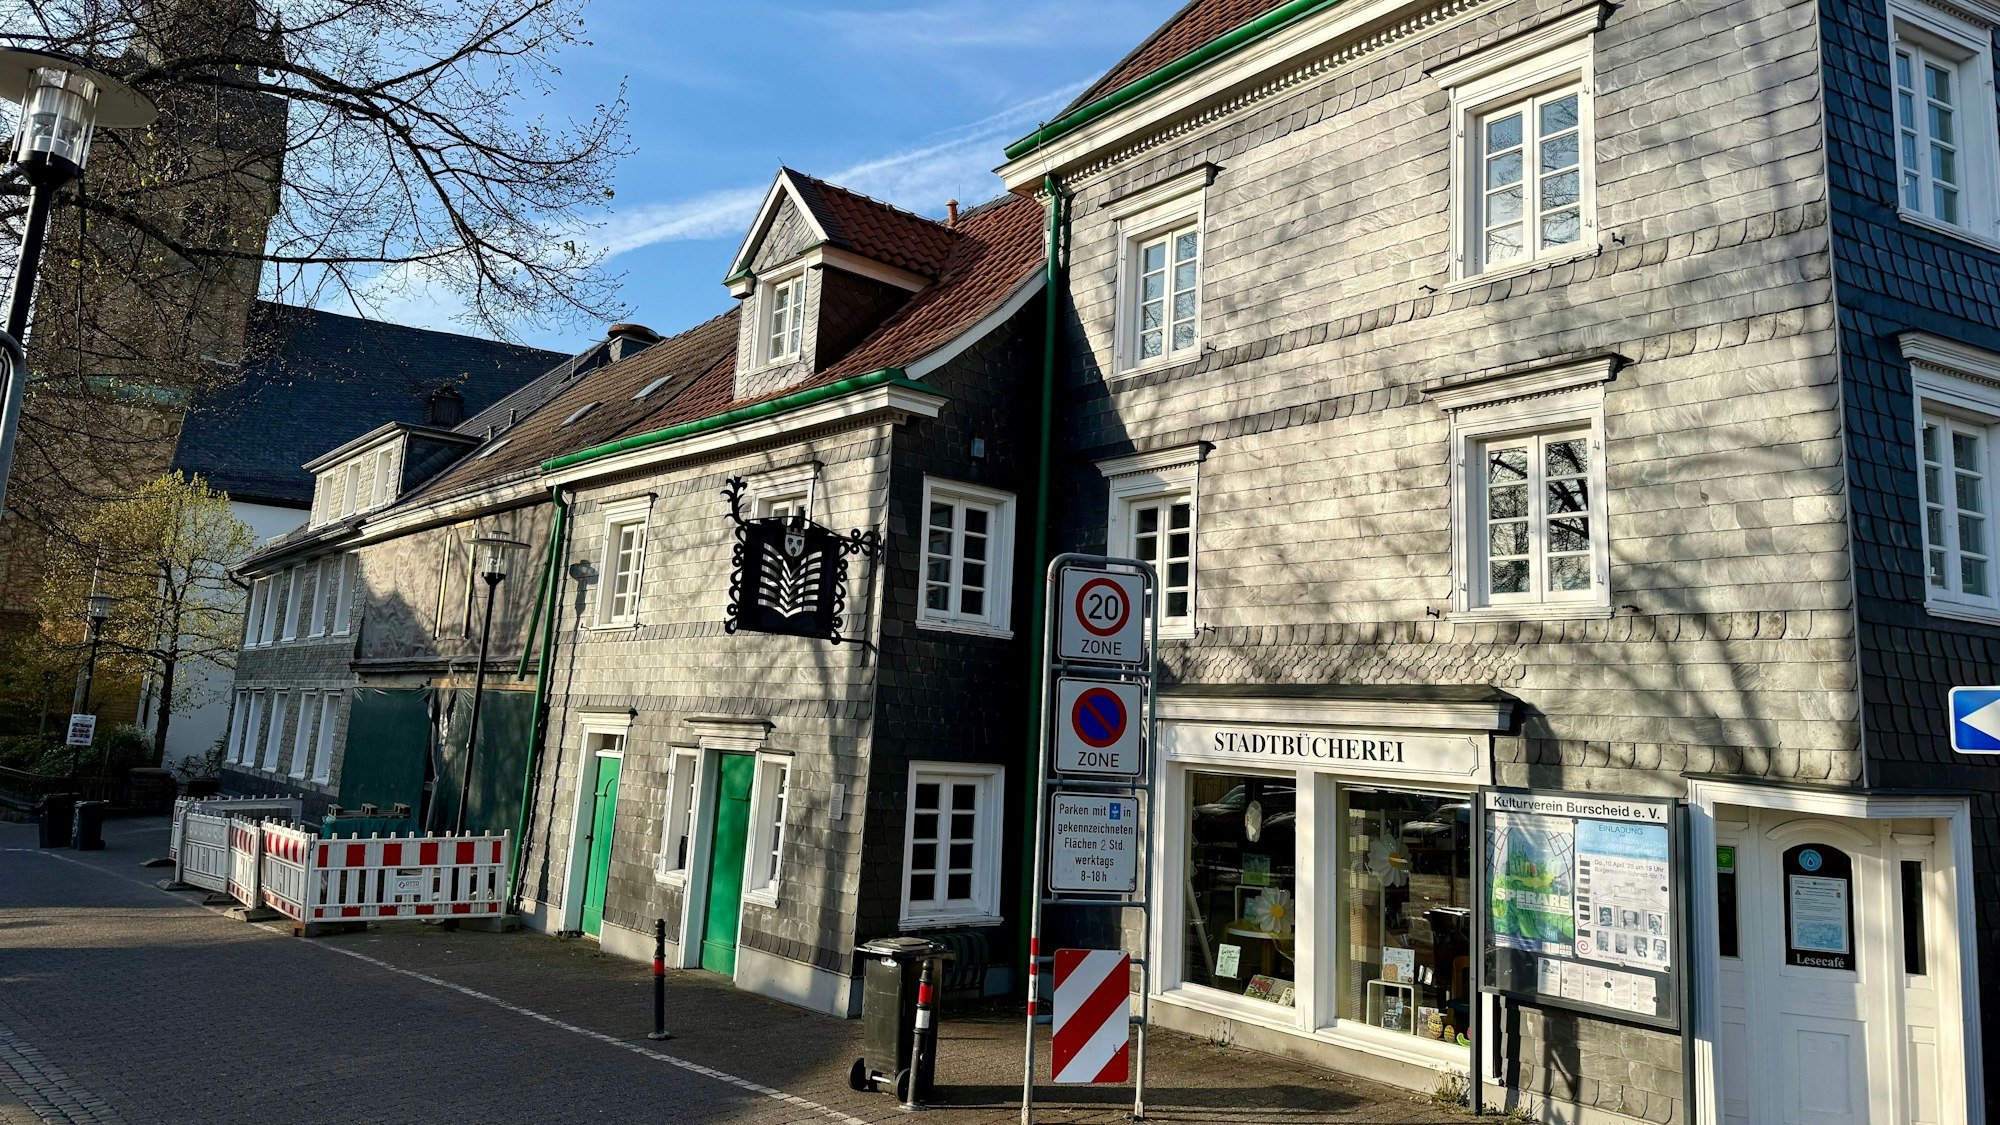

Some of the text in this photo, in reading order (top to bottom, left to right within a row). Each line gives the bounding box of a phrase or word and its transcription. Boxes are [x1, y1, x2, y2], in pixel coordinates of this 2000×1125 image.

[1088, 593, 1119, 621] 20
[1080, 639, 1122, 656] ZONE
[1214, 731, 1405, 763] STADTBÜCHEREI
[1077, 751, 1120, 768] ZONE
[1059, 803, 1131, 818] Parken mit in
[1493, 796, 1661, 820] Kulturverein Burscheid e. V.
[1057, 821, 1133, 836] gekennzeichneten
[1598, 824, 1644, 836] EINLADUNG
[1064, 837, 1125, 851] Flächen 2 Std.
[1074, 854, 1115, 868] werktags
[1495, 887, 1570, 909] SPERARE
[1796, 952, 1845, 969] Lesecafé
